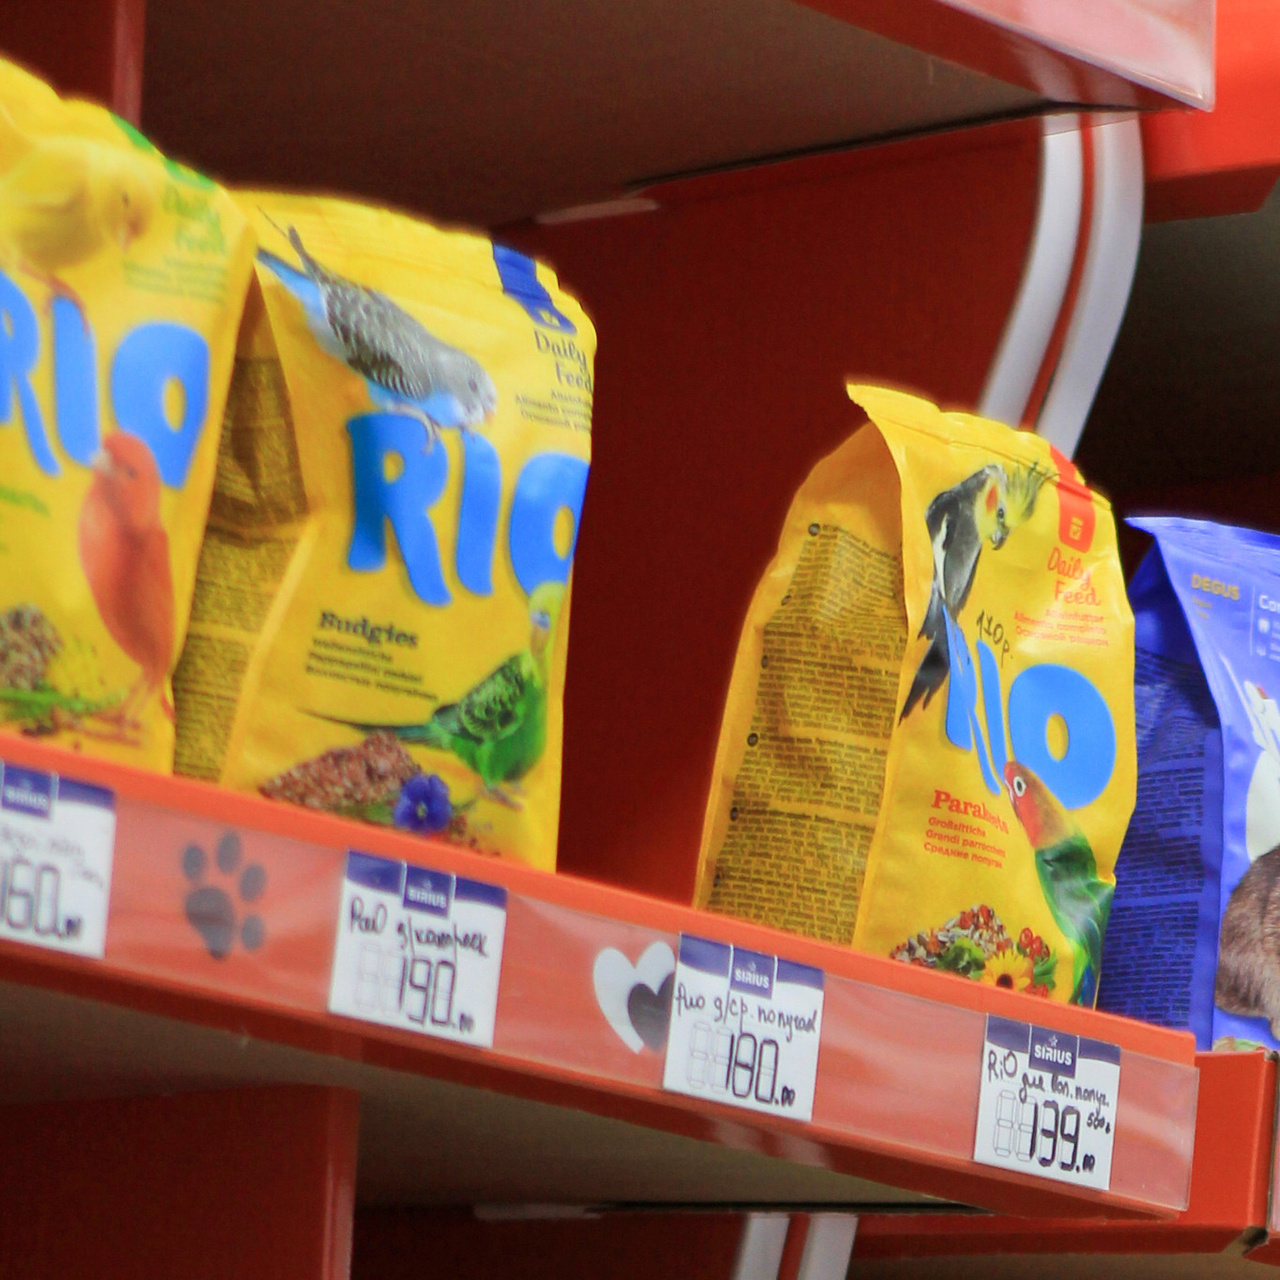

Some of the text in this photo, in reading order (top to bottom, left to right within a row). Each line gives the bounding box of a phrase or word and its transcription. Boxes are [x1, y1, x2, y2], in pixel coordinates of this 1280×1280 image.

[345, 410, 590, 607] RIO
[1046, 546, 1092, 592] Daily
[1054, 579, 1102, 607] Feed
[1191, 573, 1240, 601] DEGUS
[319, 610, 419, 648] Budgies
[734, 968, 771, 990] SIRIUS
[1033, 1042, 1073, 1067] SIRIUS
